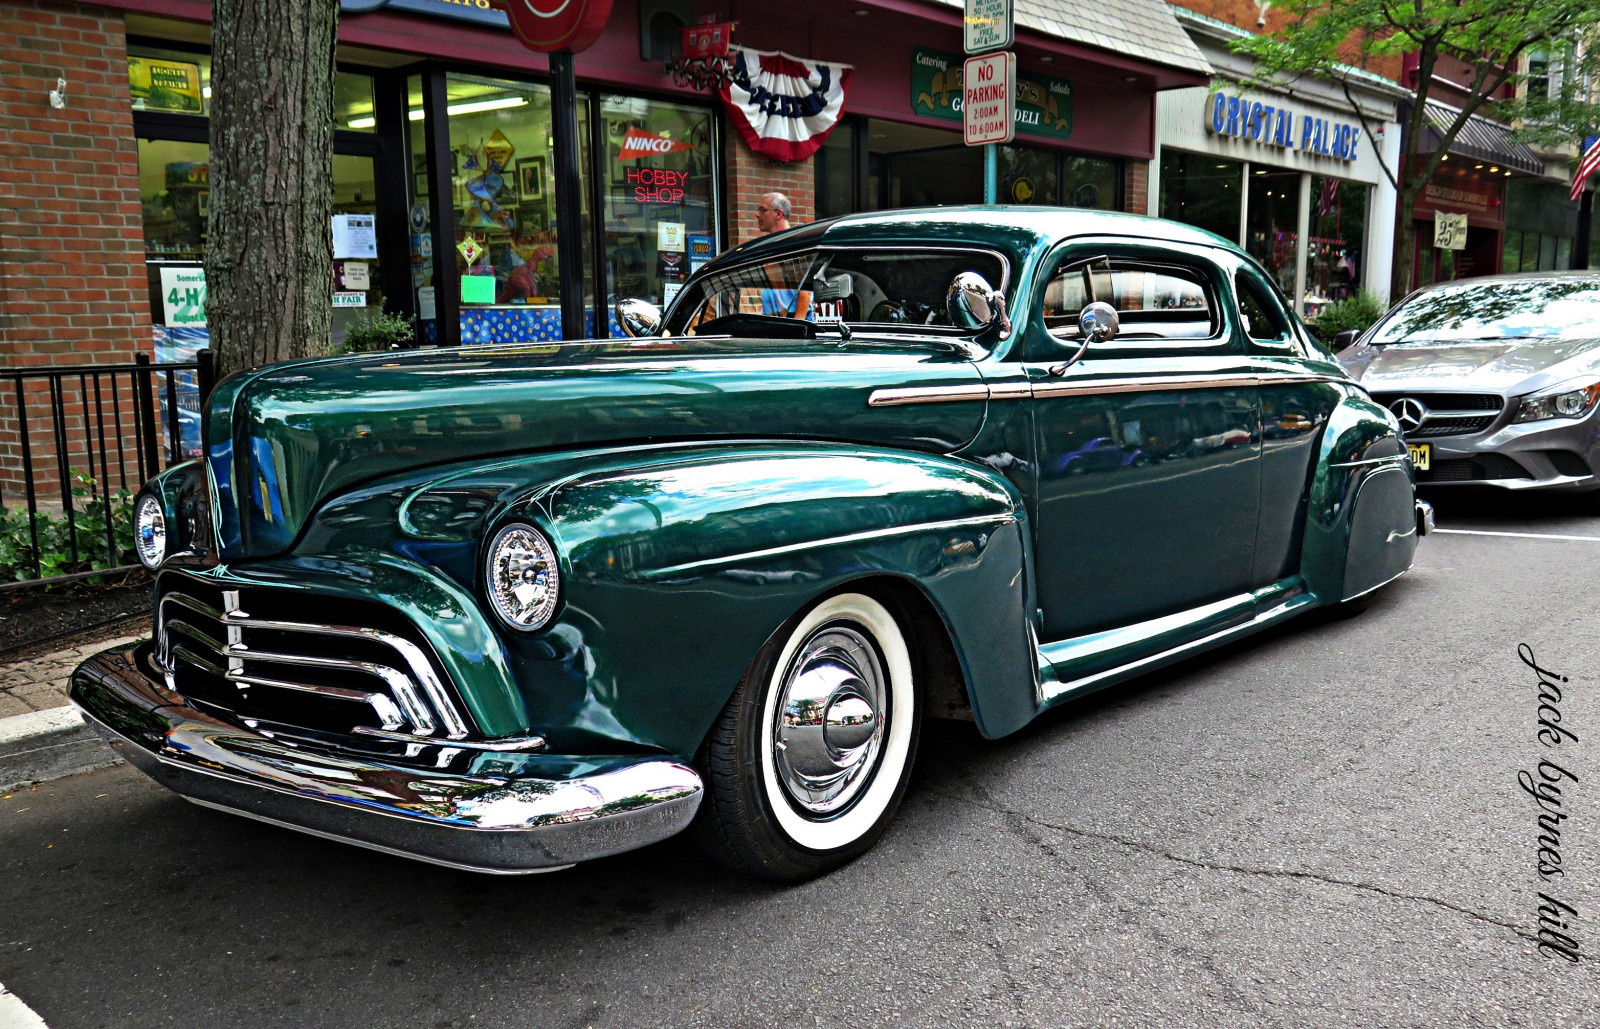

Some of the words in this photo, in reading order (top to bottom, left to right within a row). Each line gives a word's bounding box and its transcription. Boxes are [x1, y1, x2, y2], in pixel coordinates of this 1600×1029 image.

[986, 2, 1002, 12] HOUR
[980, 26, 994, 36] FREE
[973, 36, 983, 46] SAT
[988, 33, 1000, 42] SUN
[916, 52, 947, 72] Catering
[978, 64, 994, 82] NO
[968, 83, 1004, 104] PARKING
[1050, 82, 1071, 96] Salads
[974, 105, 998, 120] 2:00AM
[1015, 108, 1040, 125] DELI
[969, 124, 976, 136] TO
[979, 120, 1004, 134] 6:00AM
[1211, 92, 1294, 148] CRYSTAL
[1301, 115, 1361, 161] PALACE
[624, 136, 672, 152] NINCO
[627, 167, 688, 186] HOBBY
[634, 186, 684, 204] SHOP
[168, 288, 200, 306] 4-H
[173, 313, 198, 324] August
